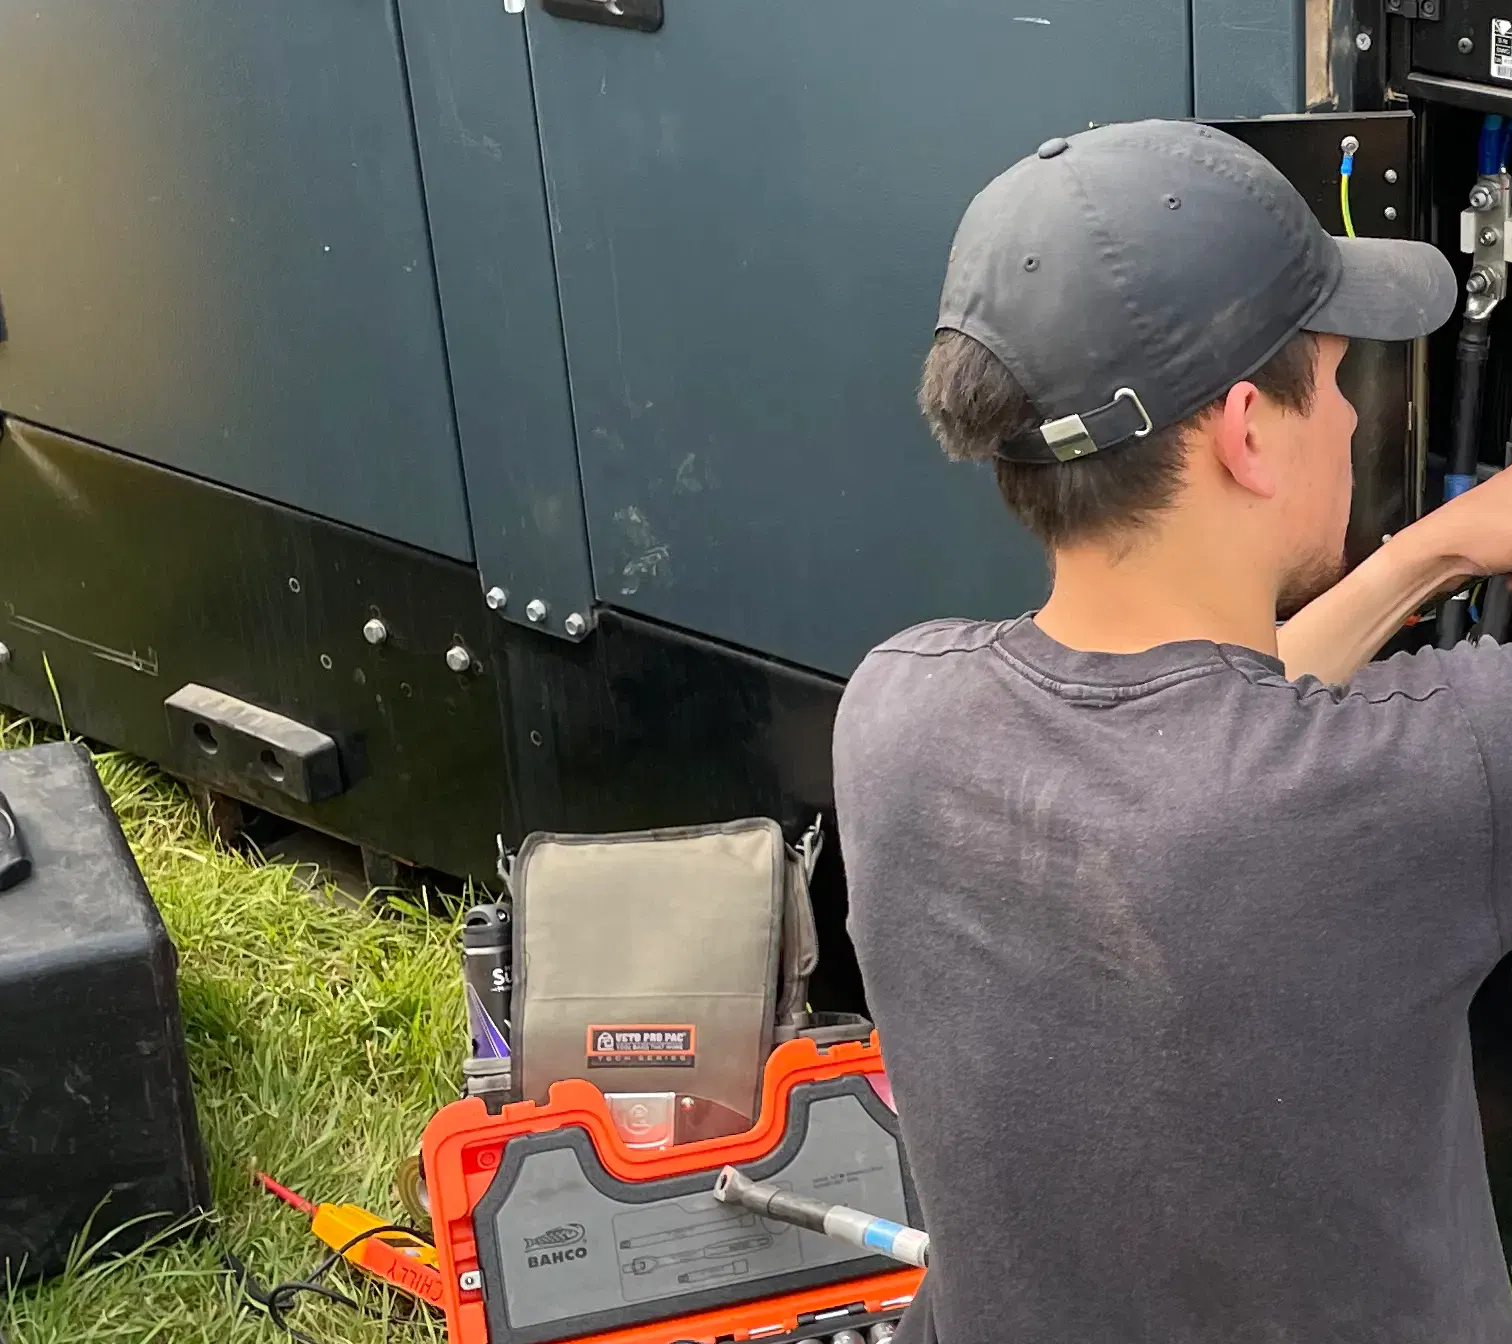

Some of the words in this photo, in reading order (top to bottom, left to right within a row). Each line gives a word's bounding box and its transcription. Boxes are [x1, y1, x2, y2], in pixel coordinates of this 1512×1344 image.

[643, 1032, 663, 1043] PRO
[664, 1031, 684, 1043] PAC
[527, 1247, 588, 1269] BAHCO
[386, 1258, 445, 1302] CHILLY
